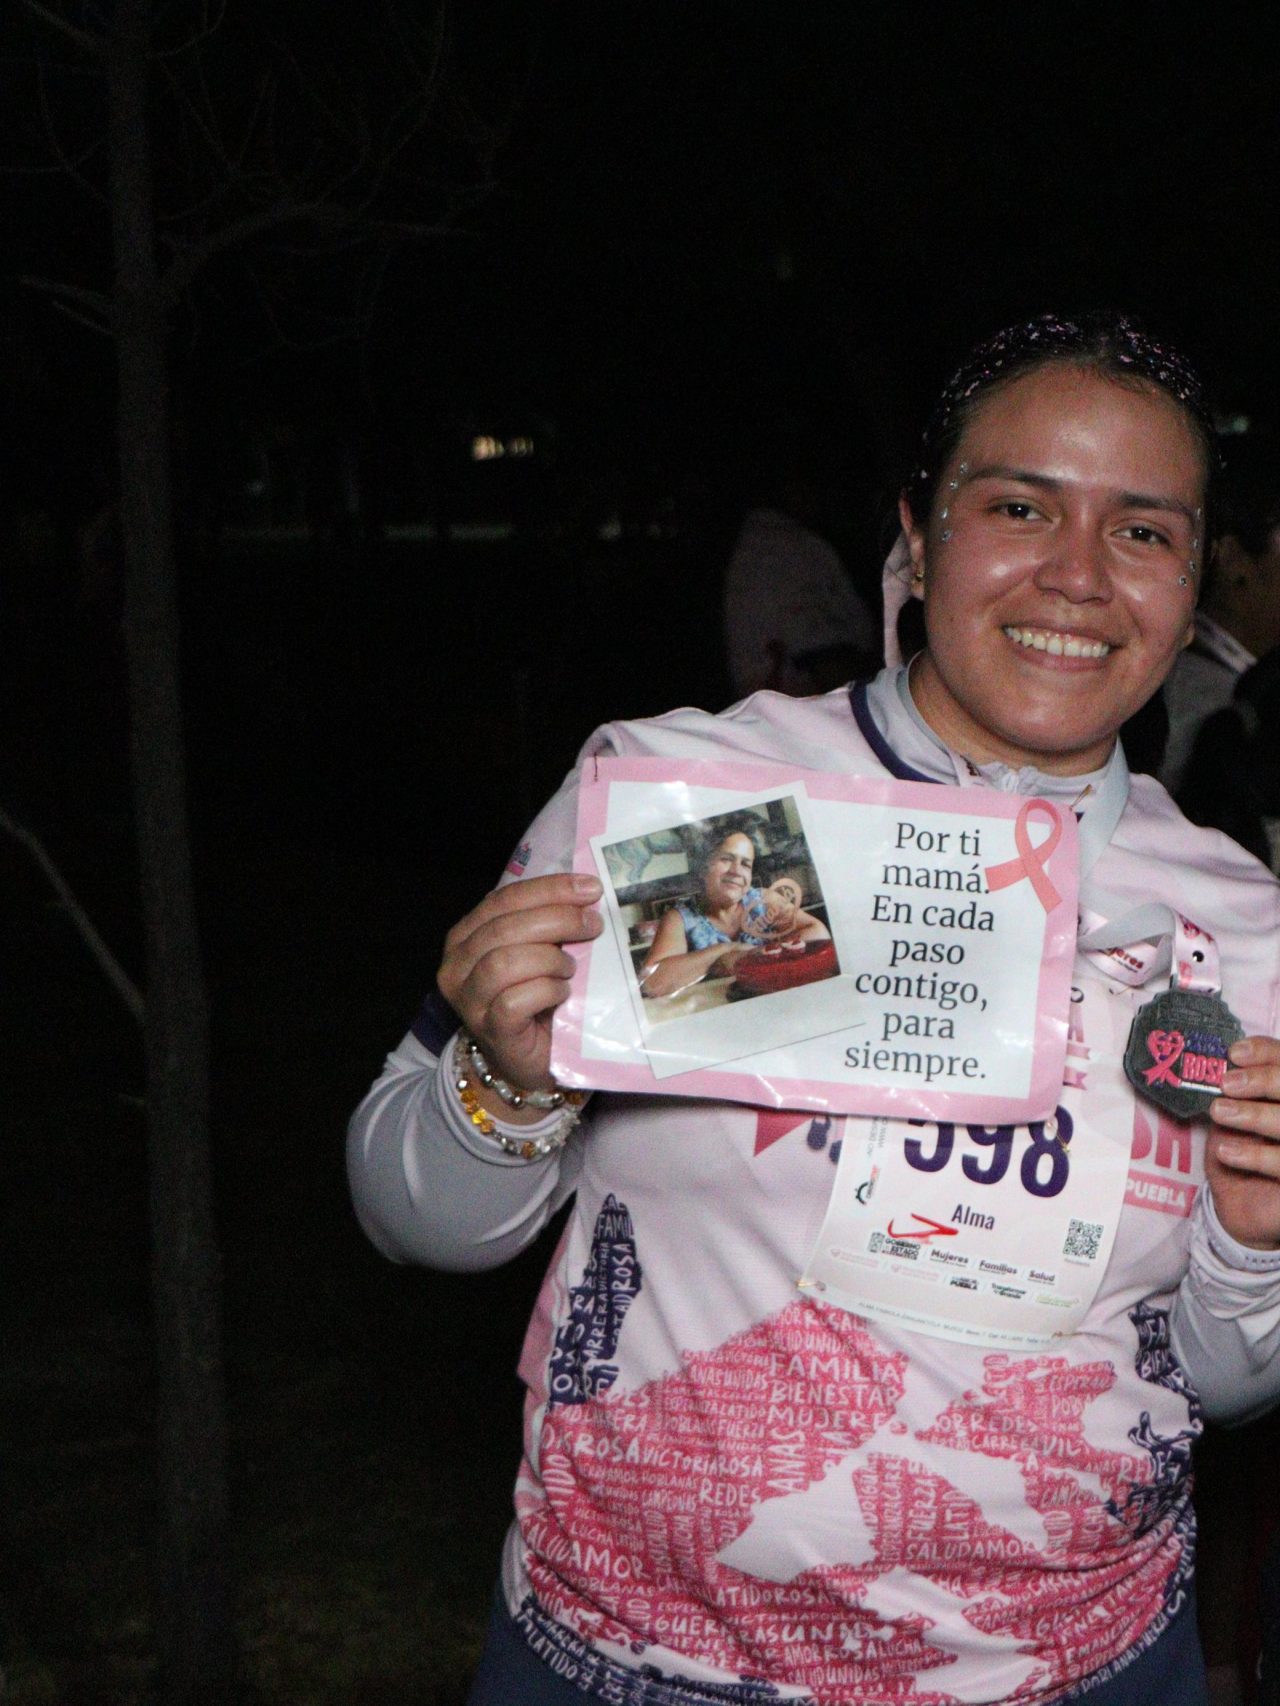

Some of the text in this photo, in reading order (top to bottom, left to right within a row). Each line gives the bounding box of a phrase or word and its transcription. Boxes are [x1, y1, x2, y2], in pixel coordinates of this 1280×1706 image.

[896, 822, 982, 856] Por ti
[881, 860, 991, 894] mamá.
[871, 895, 995, 932] En cada
[891, 937, 965, 966] paso
[855, 969, 988, 1011] contigo,
[882, 1009, 955, 1041] para
[844, 1042, 987, 1082] siempre.
[903, 1105, 1075, 1198] 598
[951, 1204, 996, 1231] Alma
[931, 1249, 1056, 1282] Mujeres Familias Salud
[769, 1353, 899, 1382] FAMILIA
[574, 1433, 640, 1463] ROSA
[718, 1456, 764, 1478] ROSA
[700, 1478, 761, 1507] REDES
[568, 1540, 651, 1579] AMOR
